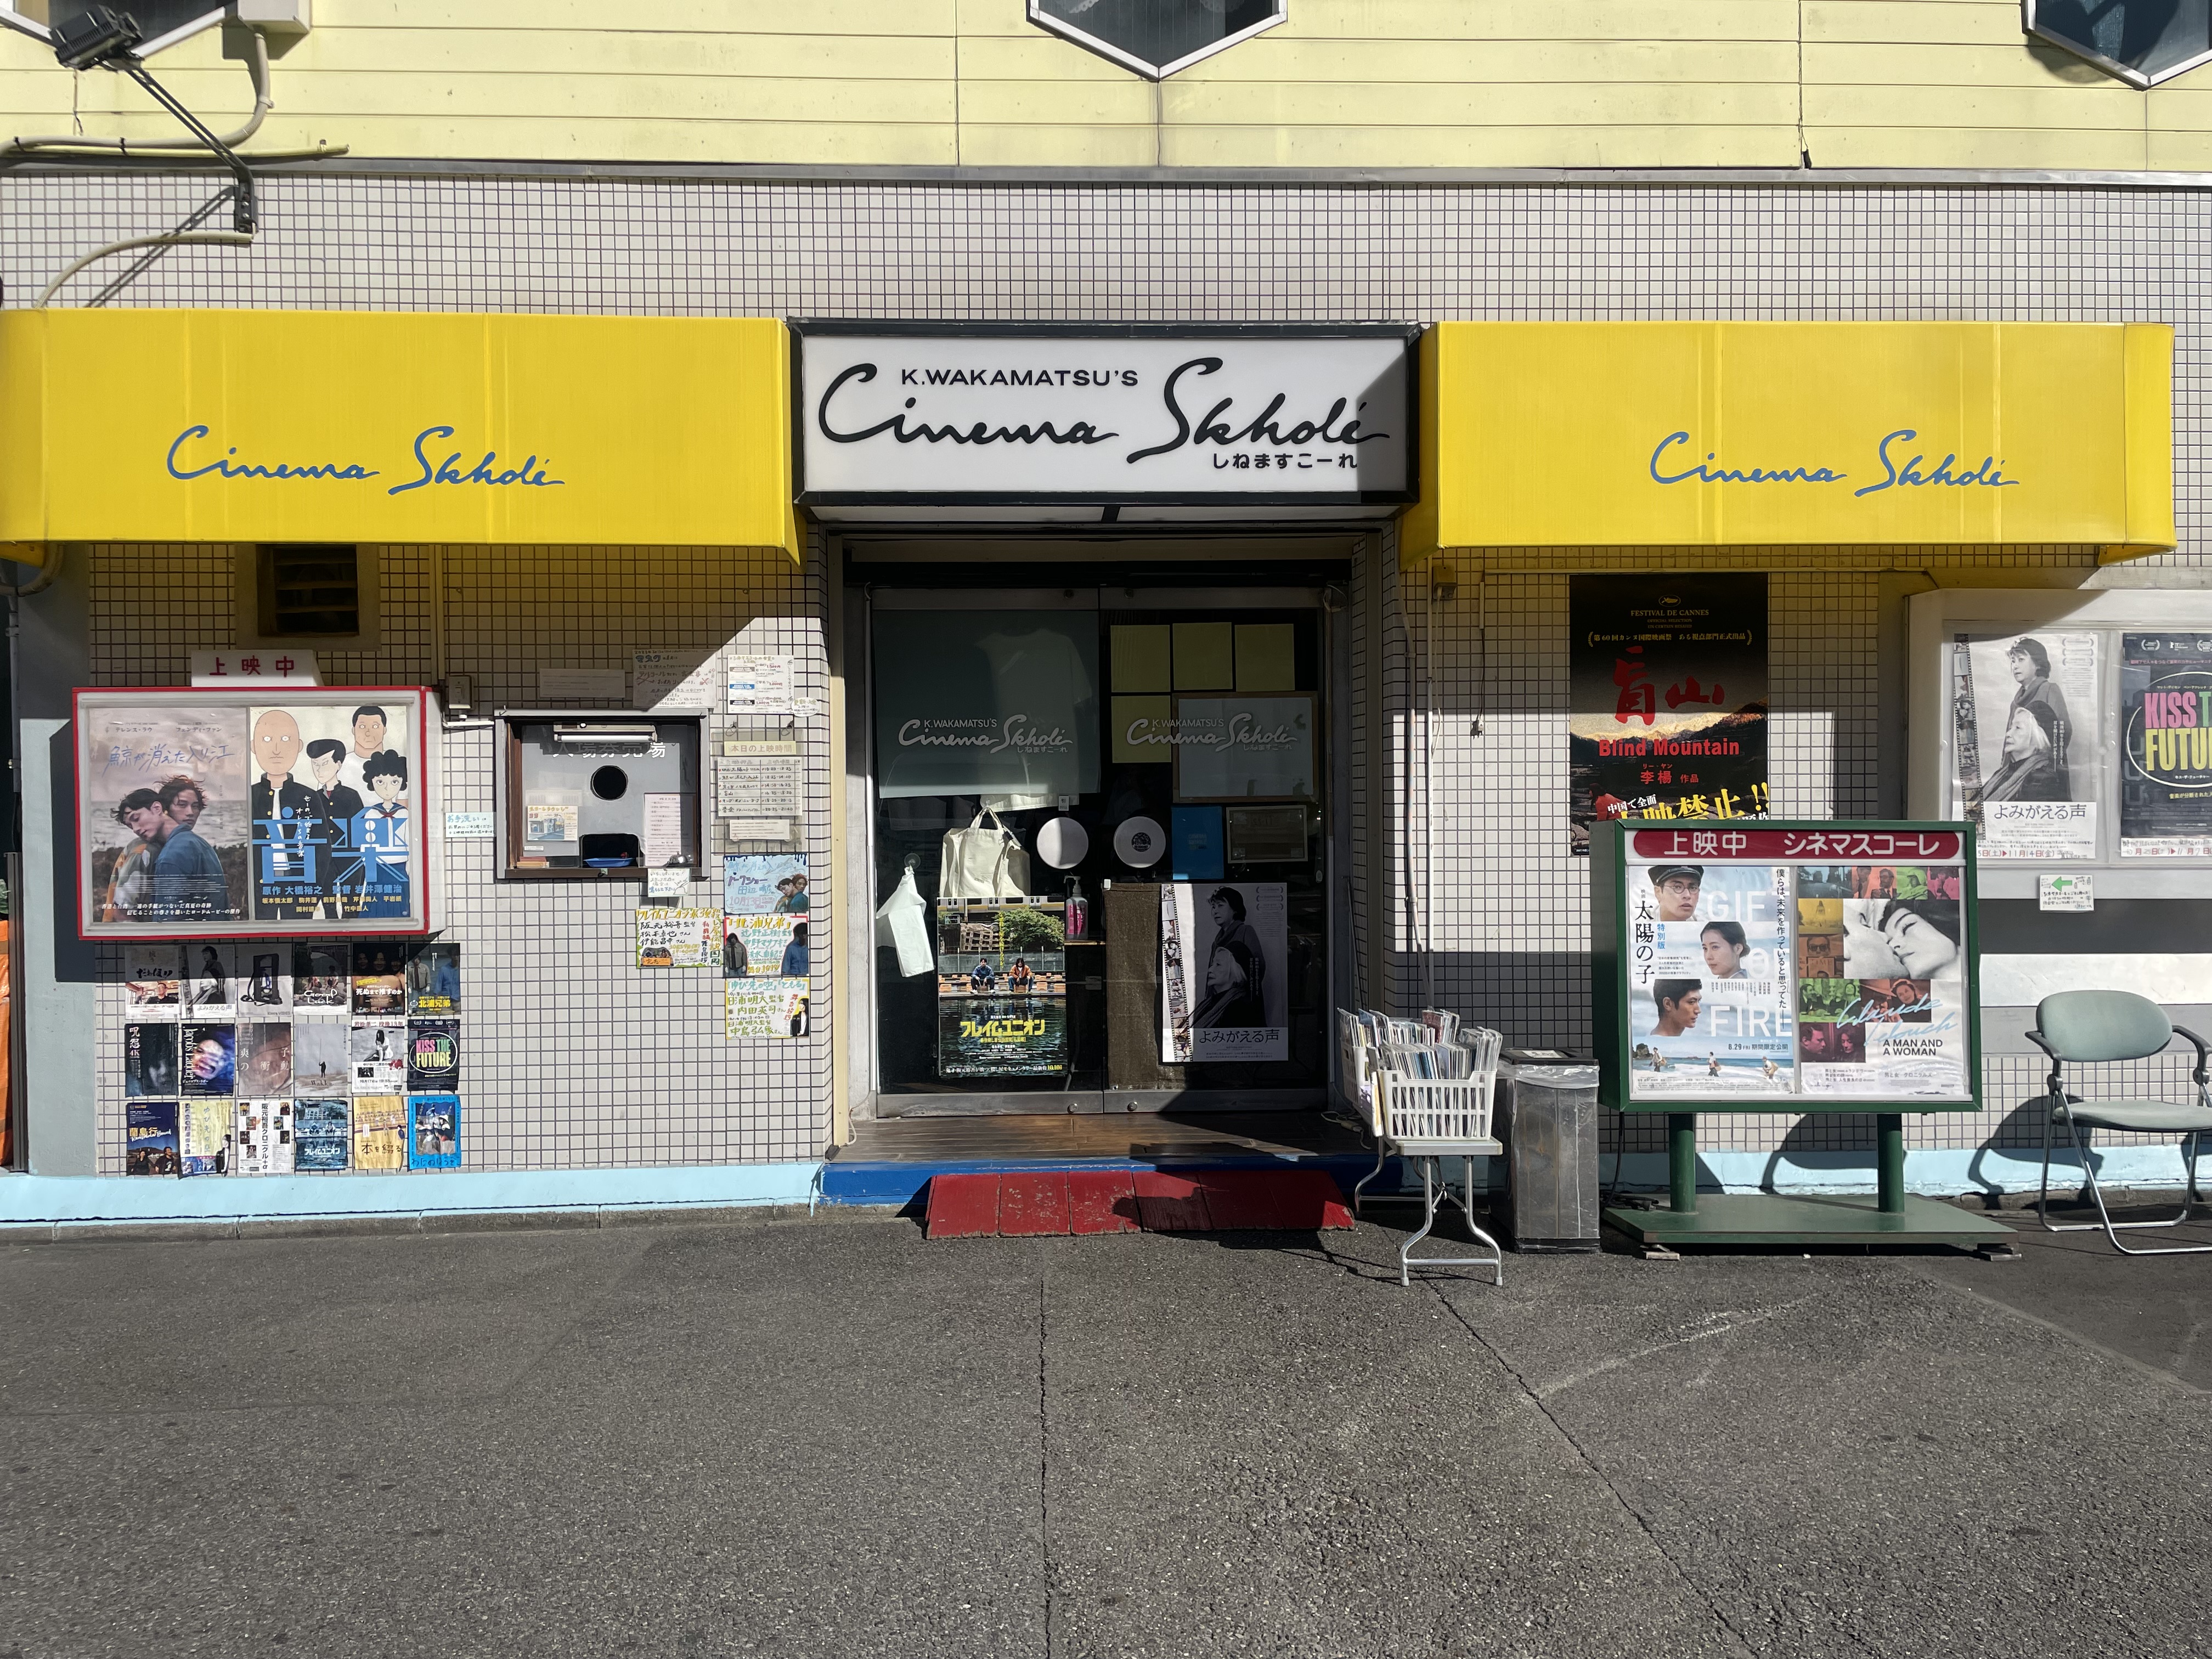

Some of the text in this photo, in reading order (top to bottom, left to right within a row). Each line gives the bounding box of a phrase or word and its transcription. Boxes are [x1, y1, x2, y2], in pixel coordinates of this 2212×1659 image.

[901, 369, 1138, 387] K.WAKAMATSU'S
[819, 363, 1119, 444] Cinema
[167, 425, 380, 481] Cinema
[1213, 452, 1357, 470] しねますこーれ
[1650, 431, 1848, 484] Cinema
[209, 657, 295, 677] 上映中
[1613, 646, 1725, 725] 盲山
[2145, 691, 2197, 729] KISS
[924, 719, 997, 729] K.WAKAMATSU'S
[1126, 718, 1228, 745] Cinema
[1152, 718, 1224, 728] K.WAKAMATSU'S
[898, 719, 1000, 746] Cinema
[731, 744, 792, 753] 本日の上映時間
[1599, 737, 1740, 757] Blind Mountain
[2145, 727, 2212, 771] FUTU
[101, 743, 235, 778] 鯨が消えた入り江
[1640, 770, 1699, 785] 李楊 作品
[1994, 804, 2087, 821] よみがえる声
[252, 806, 409, 884] 音楽
[1663, 830, 1940, 857] 上映中 シネマスコーレ
[262, 885, 281, 895] 原作
[285, 885, 323, 895] 大橋裕之
[332, 885, 351, 895] 監督
[727, 875, 768, 887] トークショー
[1634, 900, 1655, 984] 太陽の子
[1657, 923, 1666, 950] 特別版
[418, 999, 451, 1008] 北浦兄弟
[960, 1019, 1046, 1037] フレイムユニオン
[1711, 1006, 1792, 1037] FIRE
[1199, 1029, 1280, 1044] よみがえる声
[1882, 1039, 1943, 1047] A MAN AND
[416, 1039, 451, 1053] KISS THE
[1882, 1048, 1937, 1056] A WOMAN
[416, 1052, 451, 1068] FUTURE
[304, 1147, 341, 1156] フレイムユニオン
